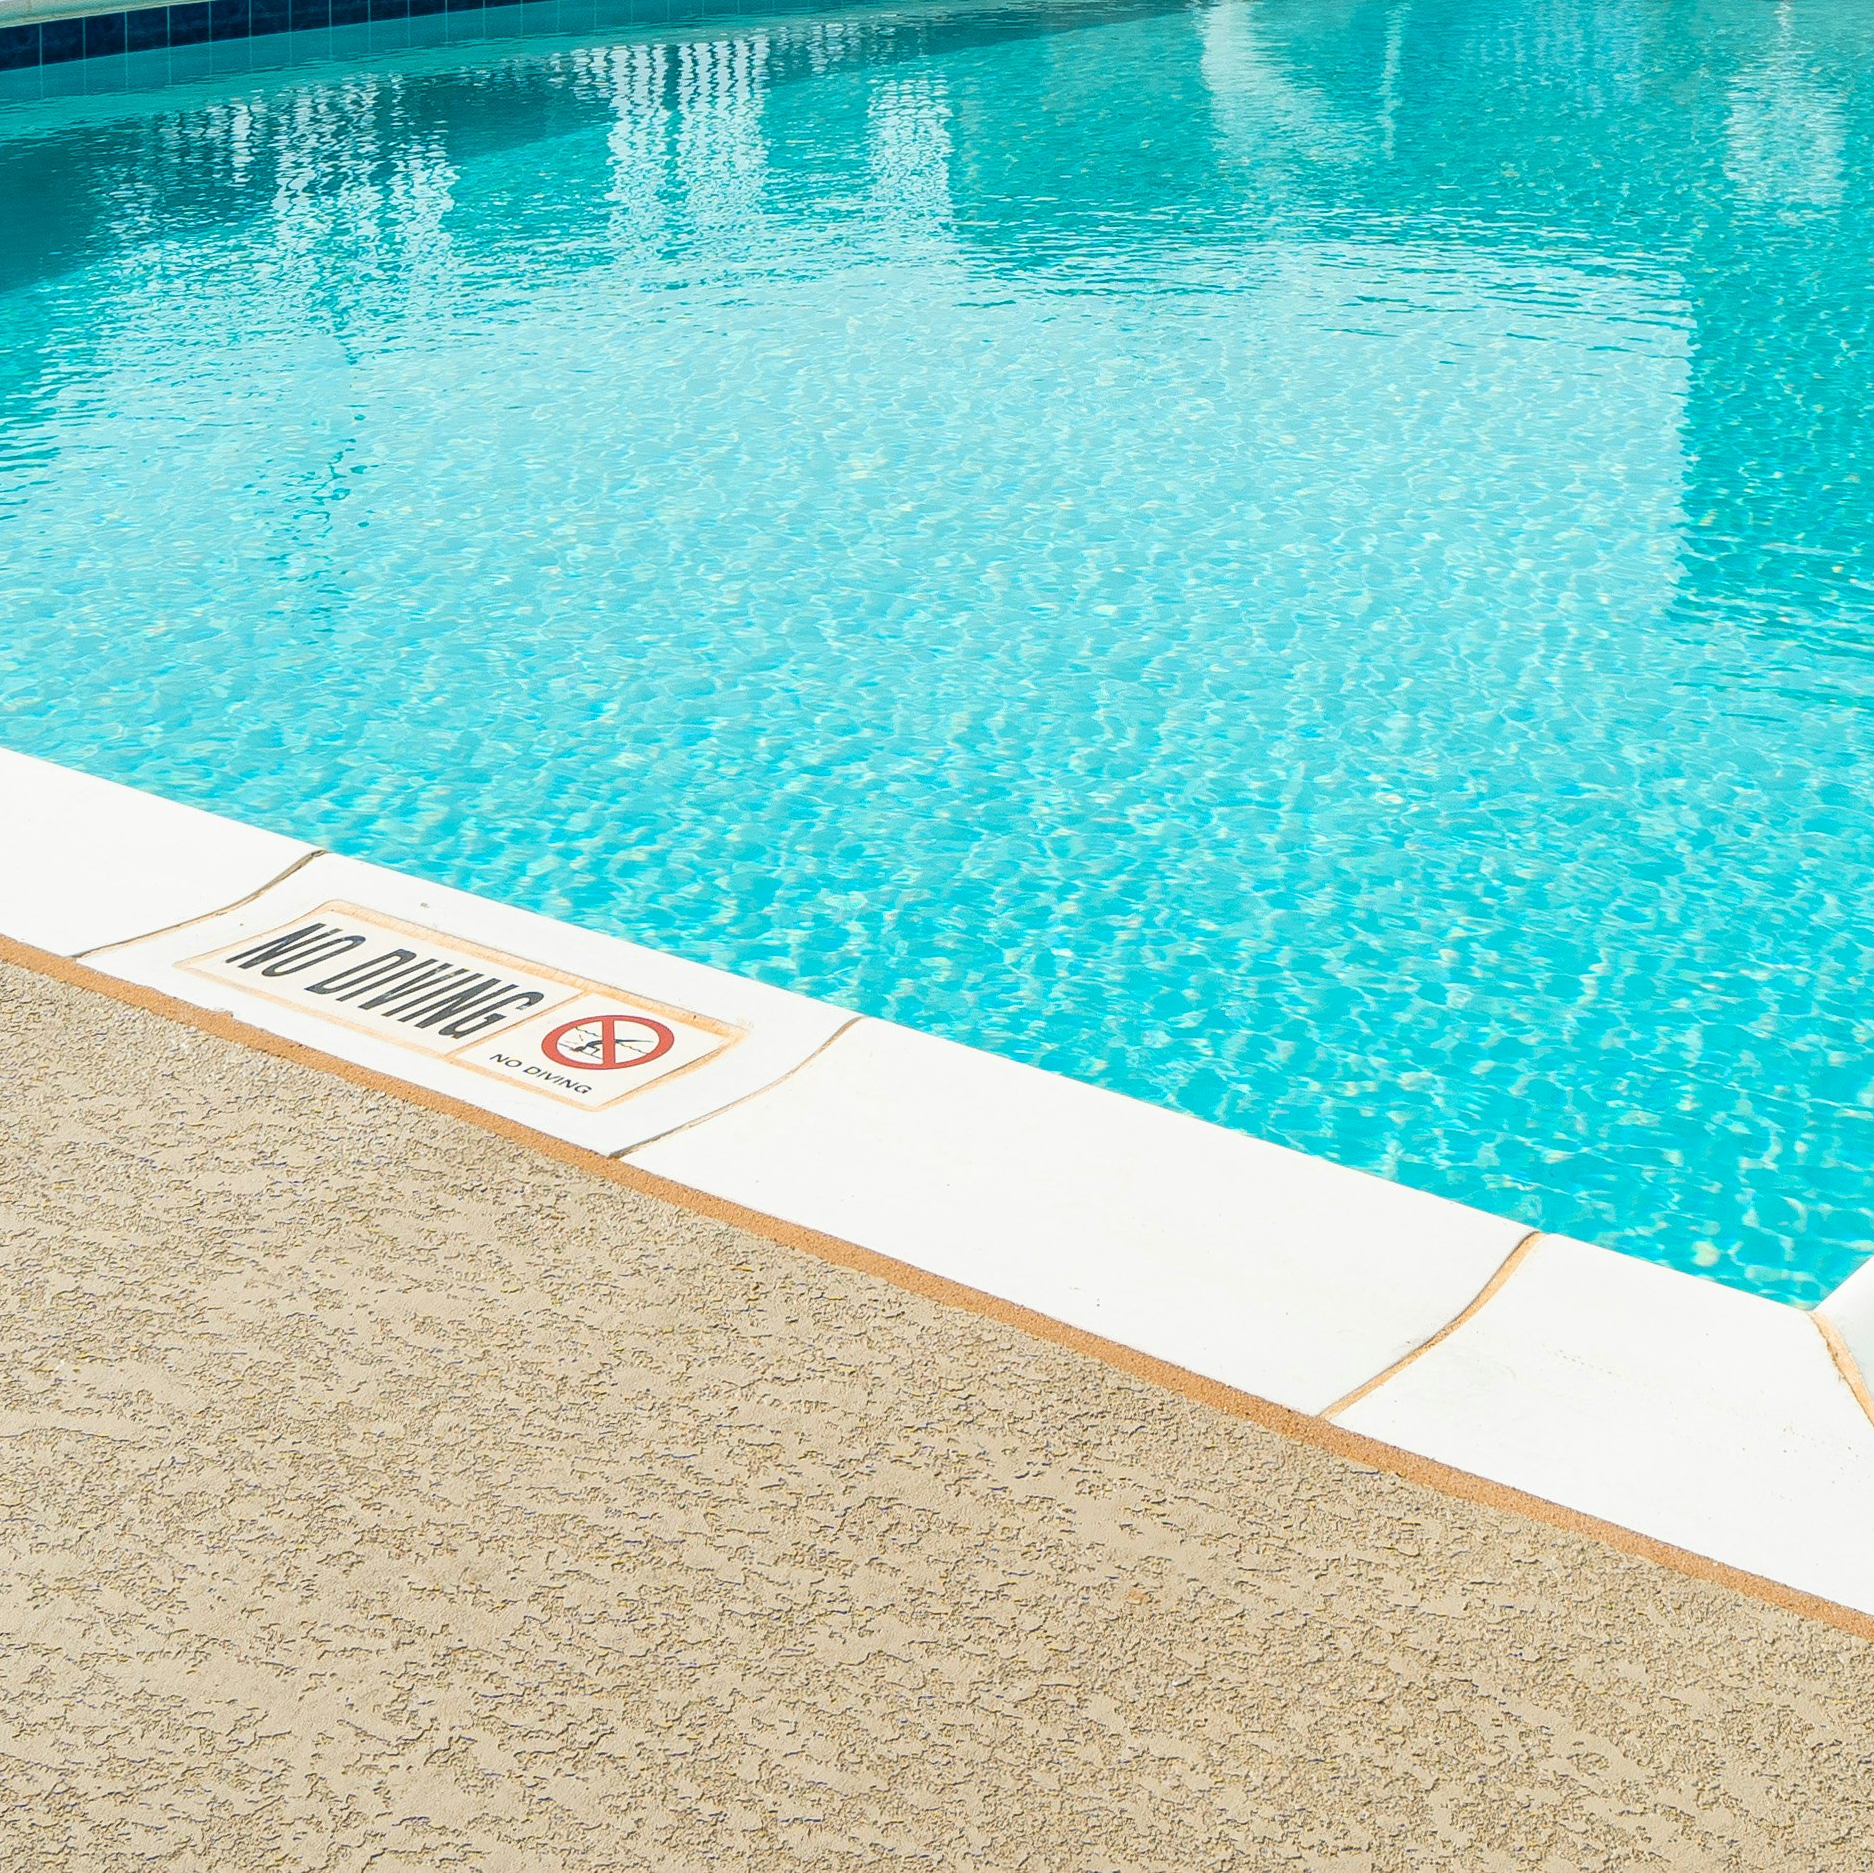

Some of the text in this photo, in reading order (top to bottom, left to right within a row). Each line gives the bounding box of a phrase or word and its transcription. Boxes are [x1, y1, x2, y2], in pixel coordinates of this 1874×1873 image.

[225, 923, 545, 1039] NO DIVING
[490, 1054, 593, 1095] NO DIVING
